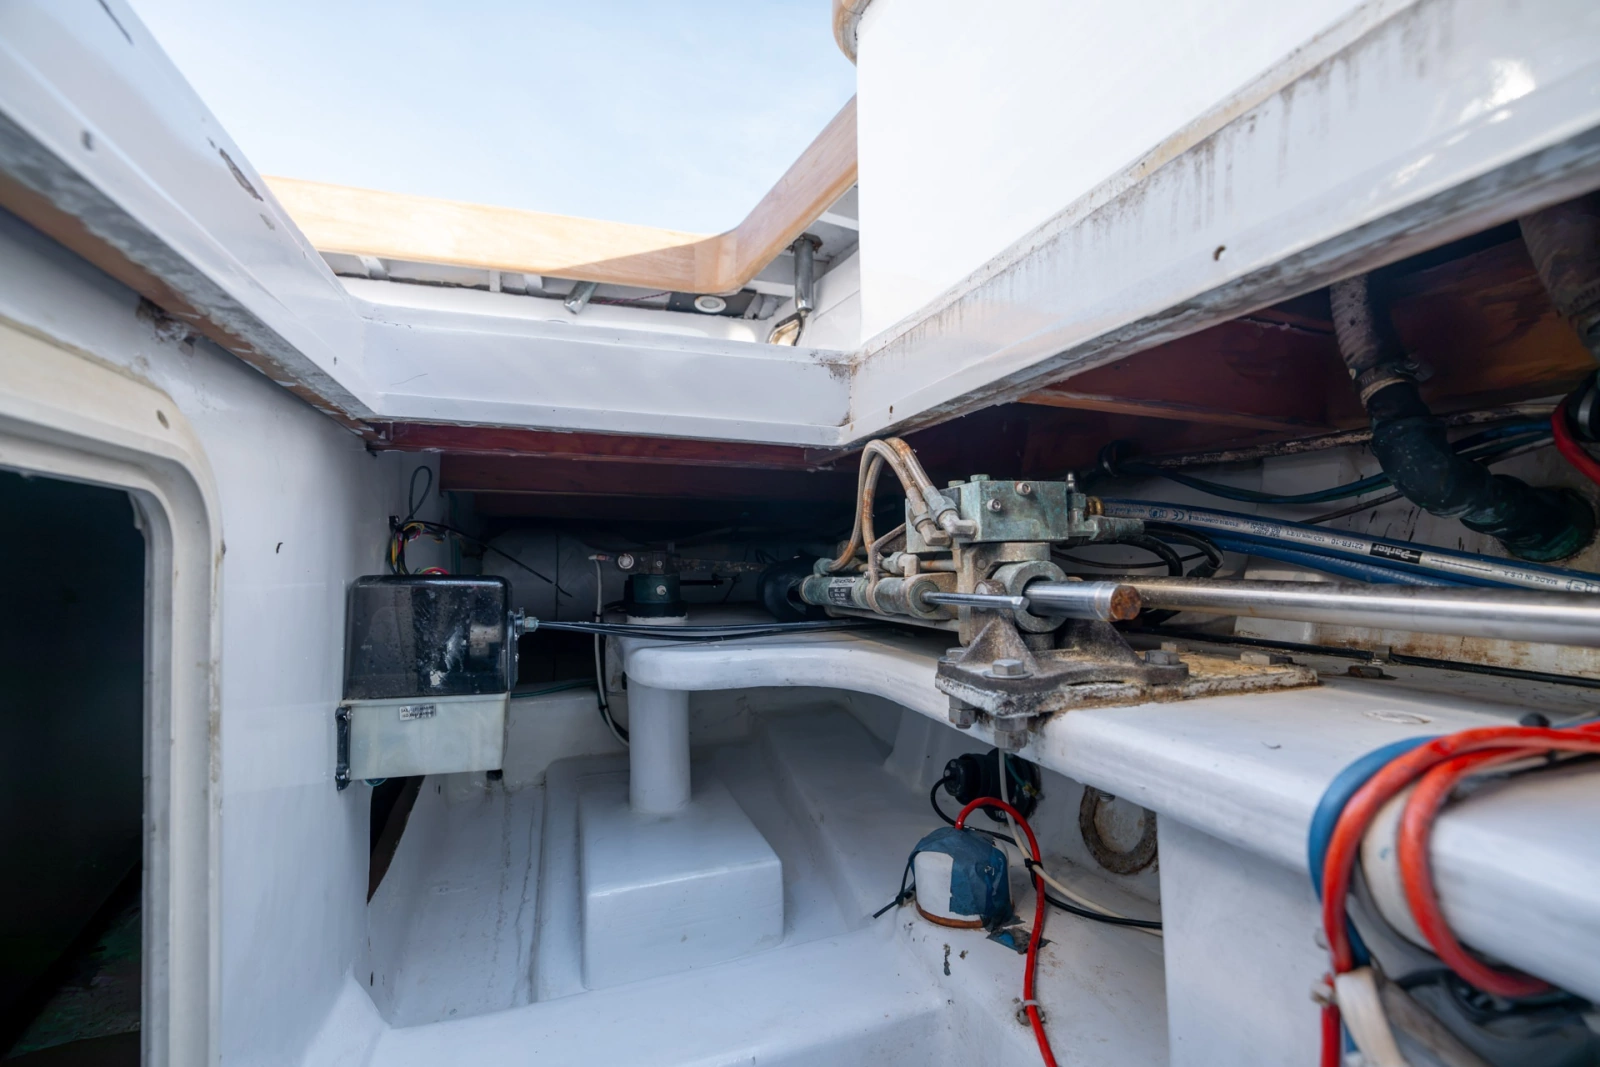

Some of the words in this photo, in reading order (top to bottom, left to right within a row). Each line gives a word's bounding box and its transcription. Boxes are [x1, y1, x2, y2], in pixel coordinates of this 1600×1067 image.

[1331, 538, 1364, 550] 221FR-10
[1373, 544, 1412, 559] Parker
[1534, 576, 1558, 585] MADE
